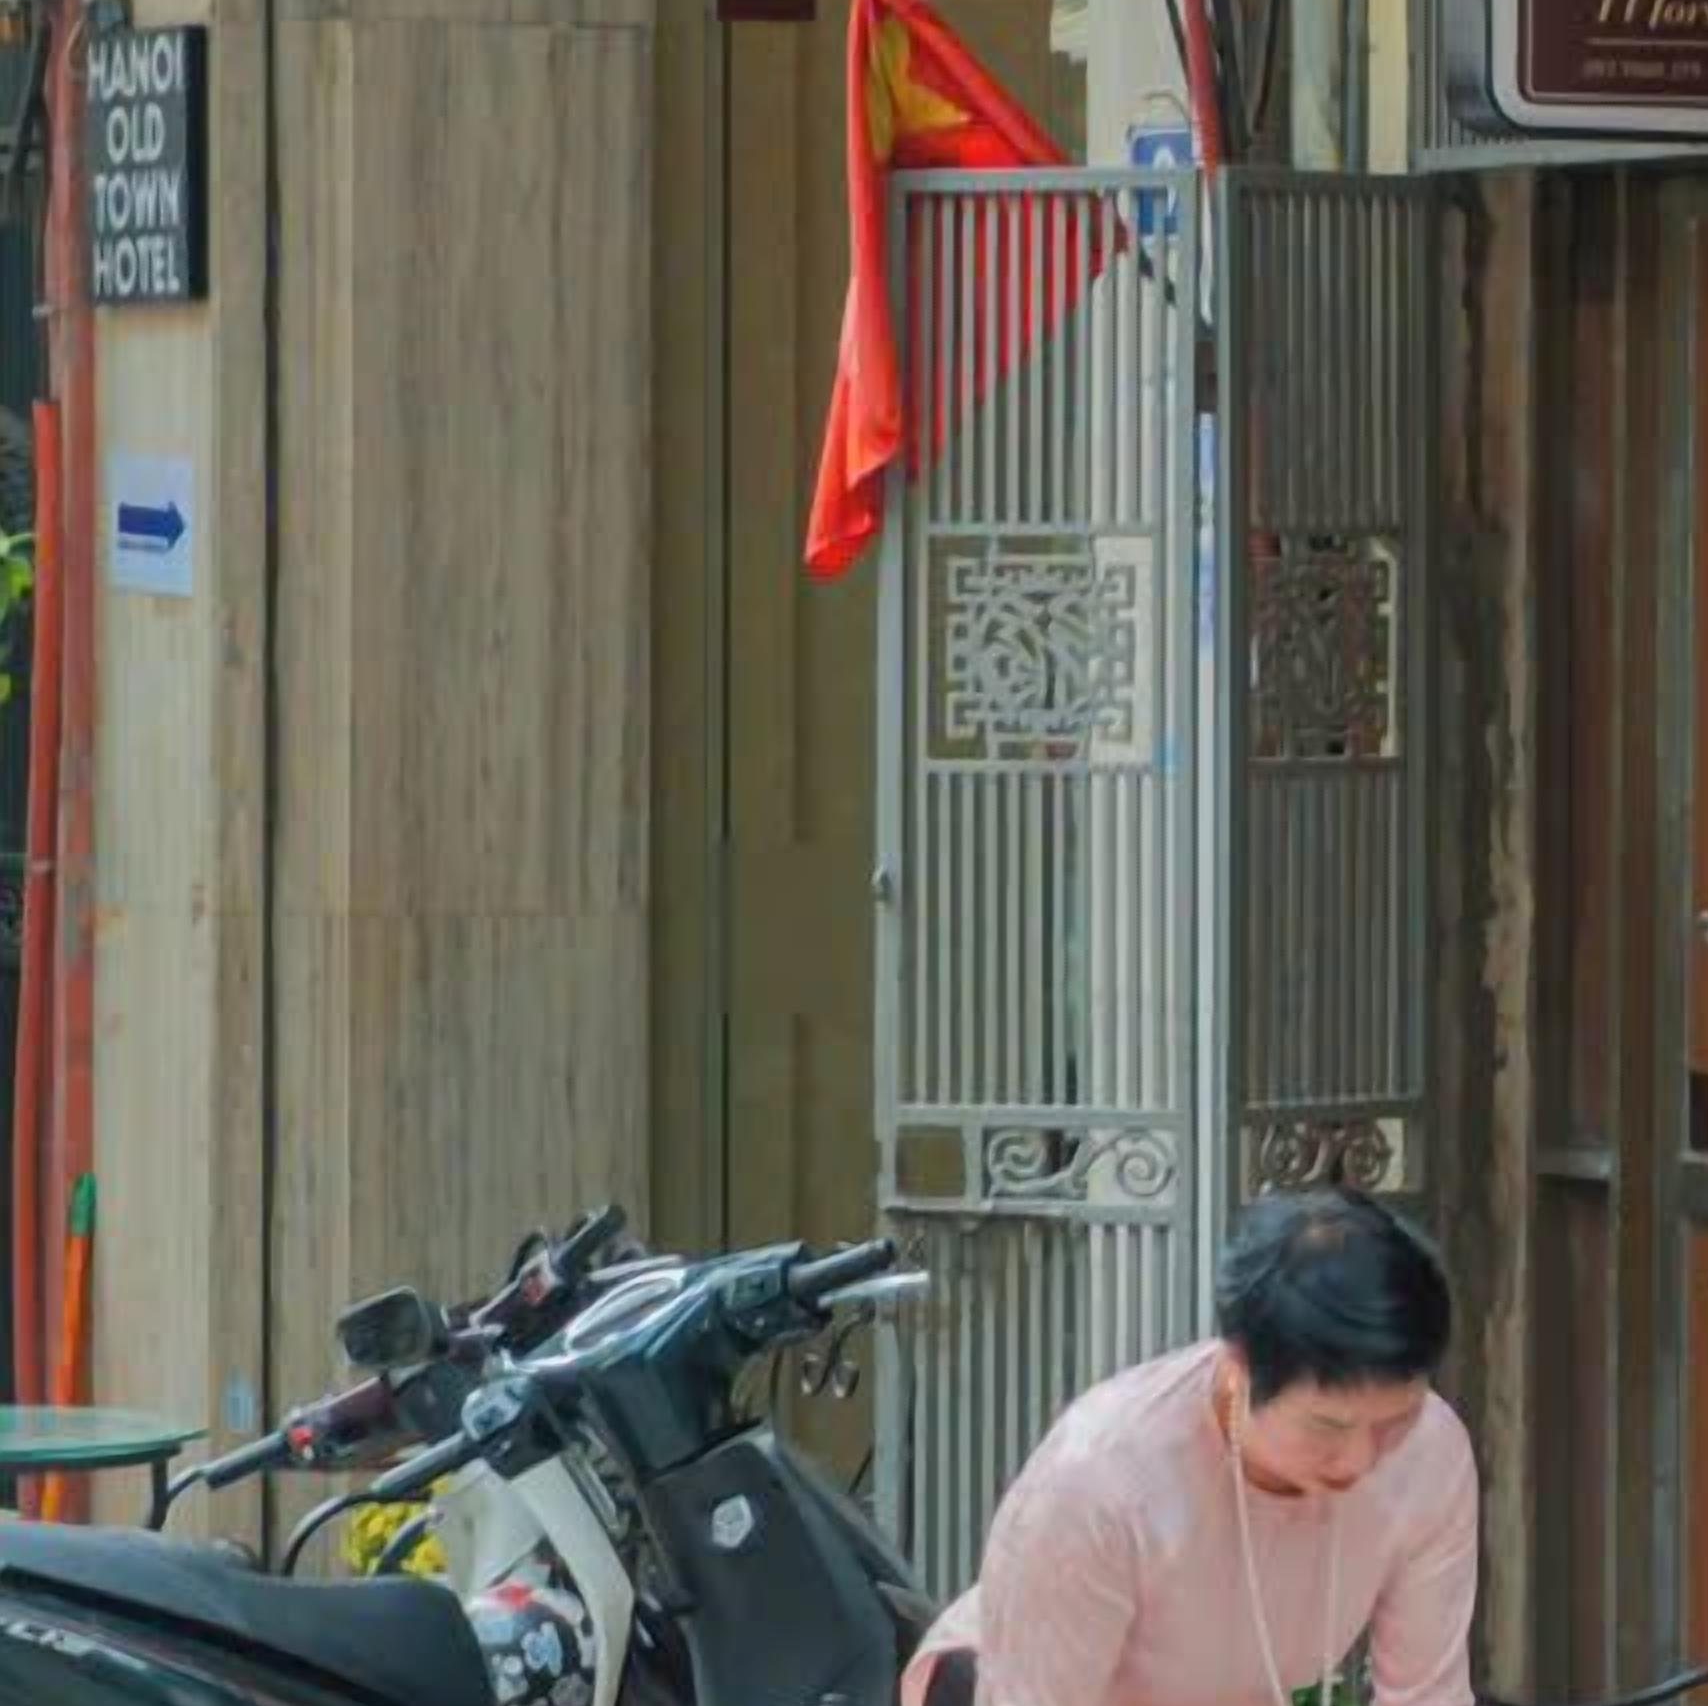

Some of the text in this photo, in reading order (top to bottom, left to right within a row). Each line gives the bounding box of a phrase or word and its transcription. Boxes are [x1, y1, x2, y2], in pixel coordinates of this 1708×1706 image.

[87, 33, 184, 102] HANOI
[106, 102, 166, 164] OLD
[93, 169, 182, 232] TOWN
[93, 235, 180, 297] HOTEL
